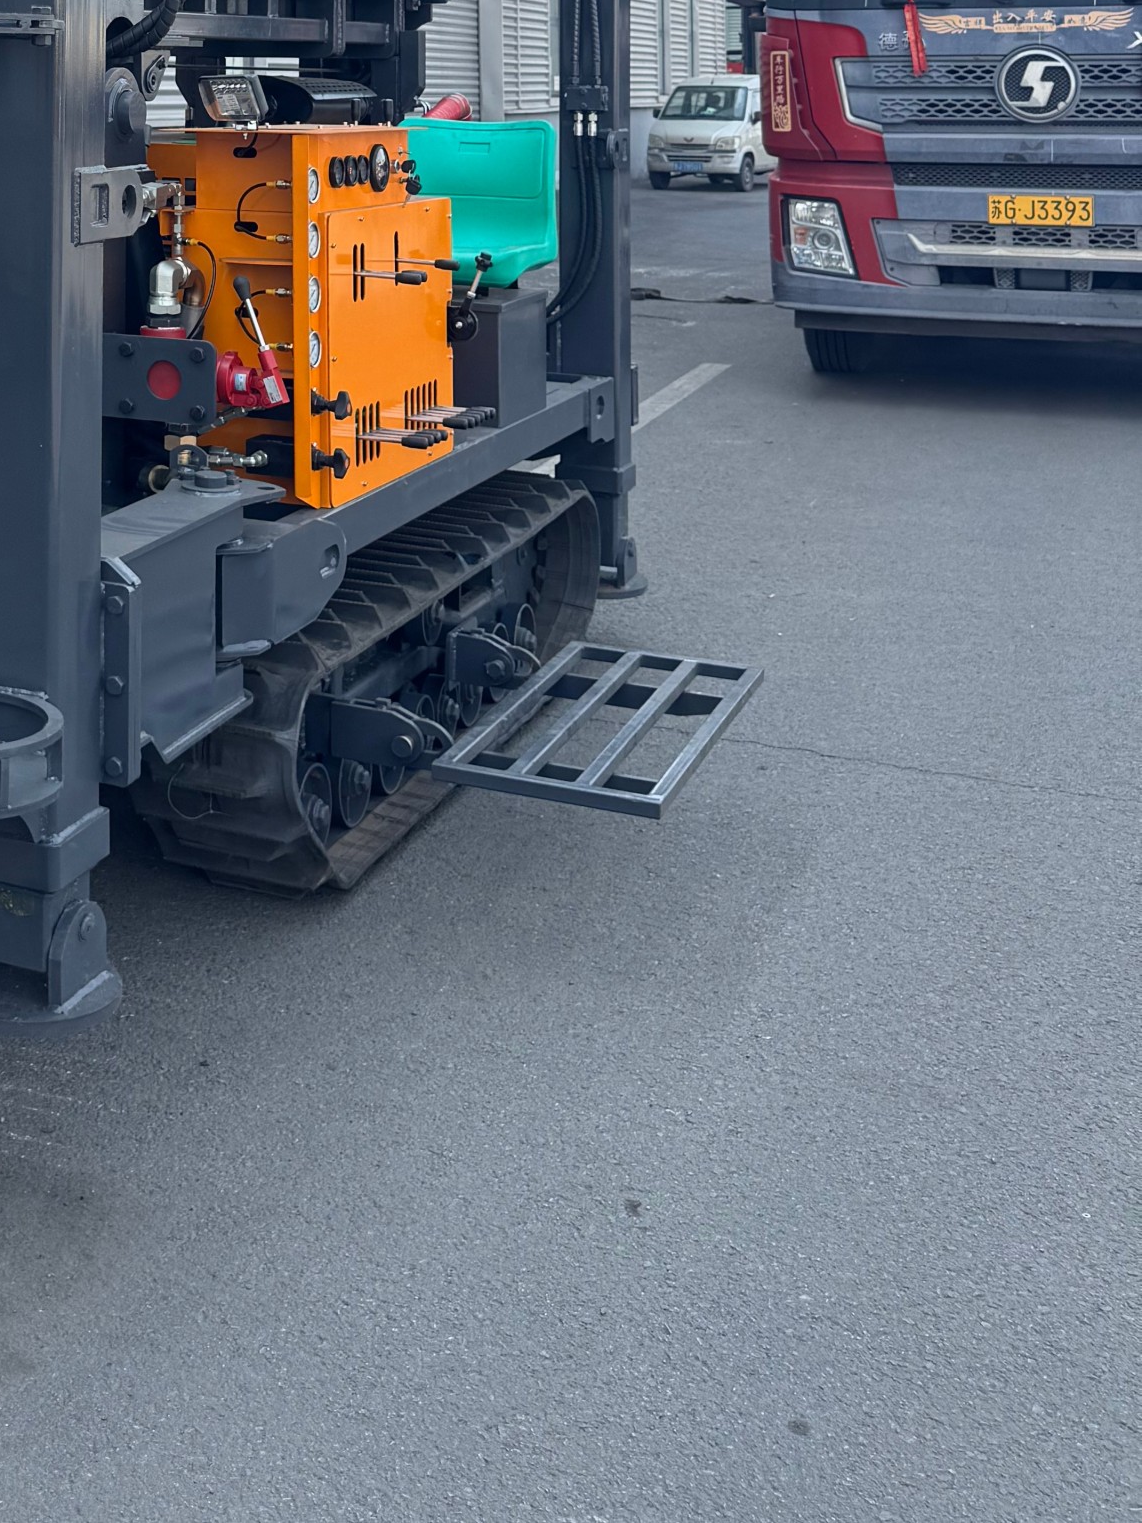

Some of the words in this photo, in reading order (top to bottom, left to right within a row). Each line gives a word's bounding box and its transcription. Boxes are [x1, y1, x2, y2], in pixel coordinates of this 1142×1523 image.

[992, 8, 1057, 25] 出入平安
[991, 198, 1091, 222] 苏G·J3393
